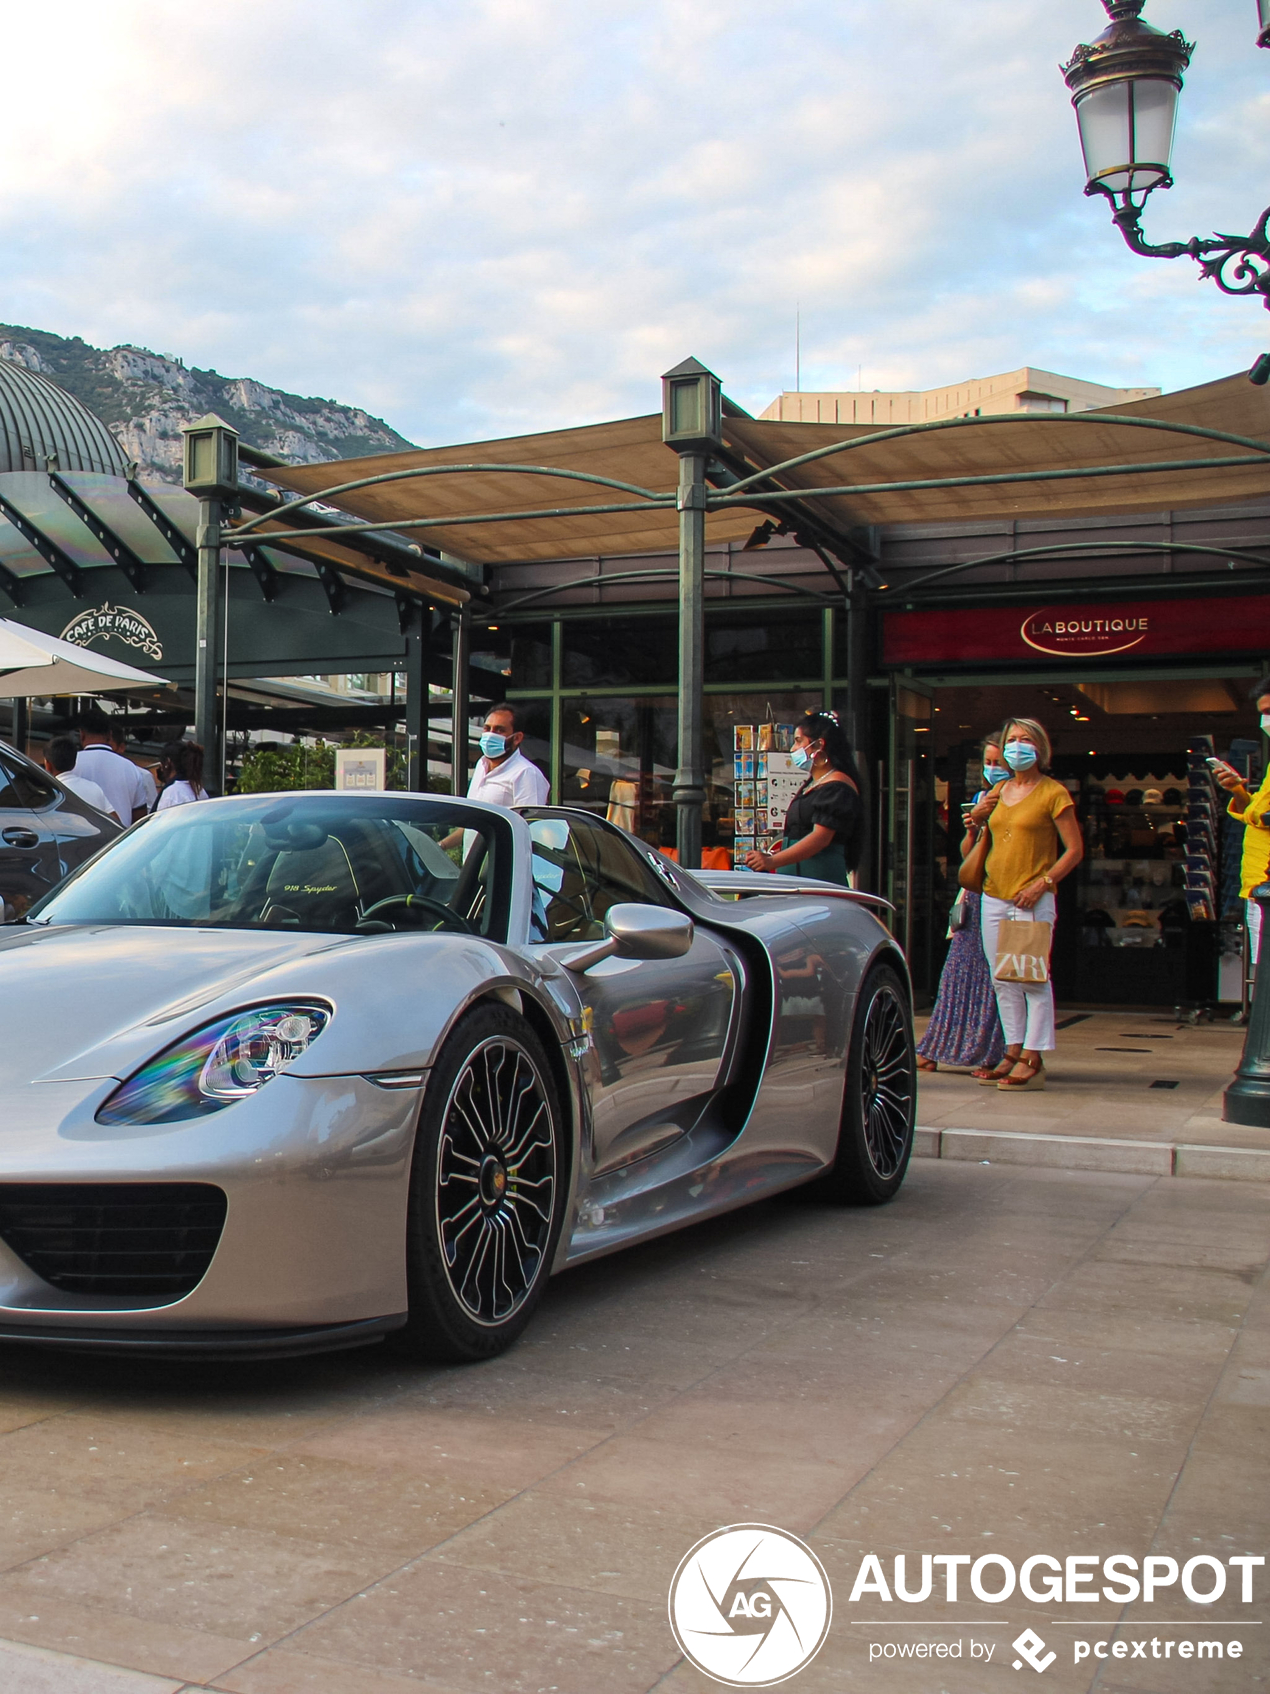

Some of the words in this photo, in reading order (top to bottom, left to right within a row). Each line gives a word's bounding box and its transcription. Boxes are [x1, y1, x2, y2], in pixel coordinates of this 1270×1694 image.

[66, 618, 95, 642] CAFE
[98, 615, 113, 627] DE
[115, 615, 149, 639] PARIS
[301, 884, 338, 894] Spyder
[994, 953, 1048, 980] ZARA
